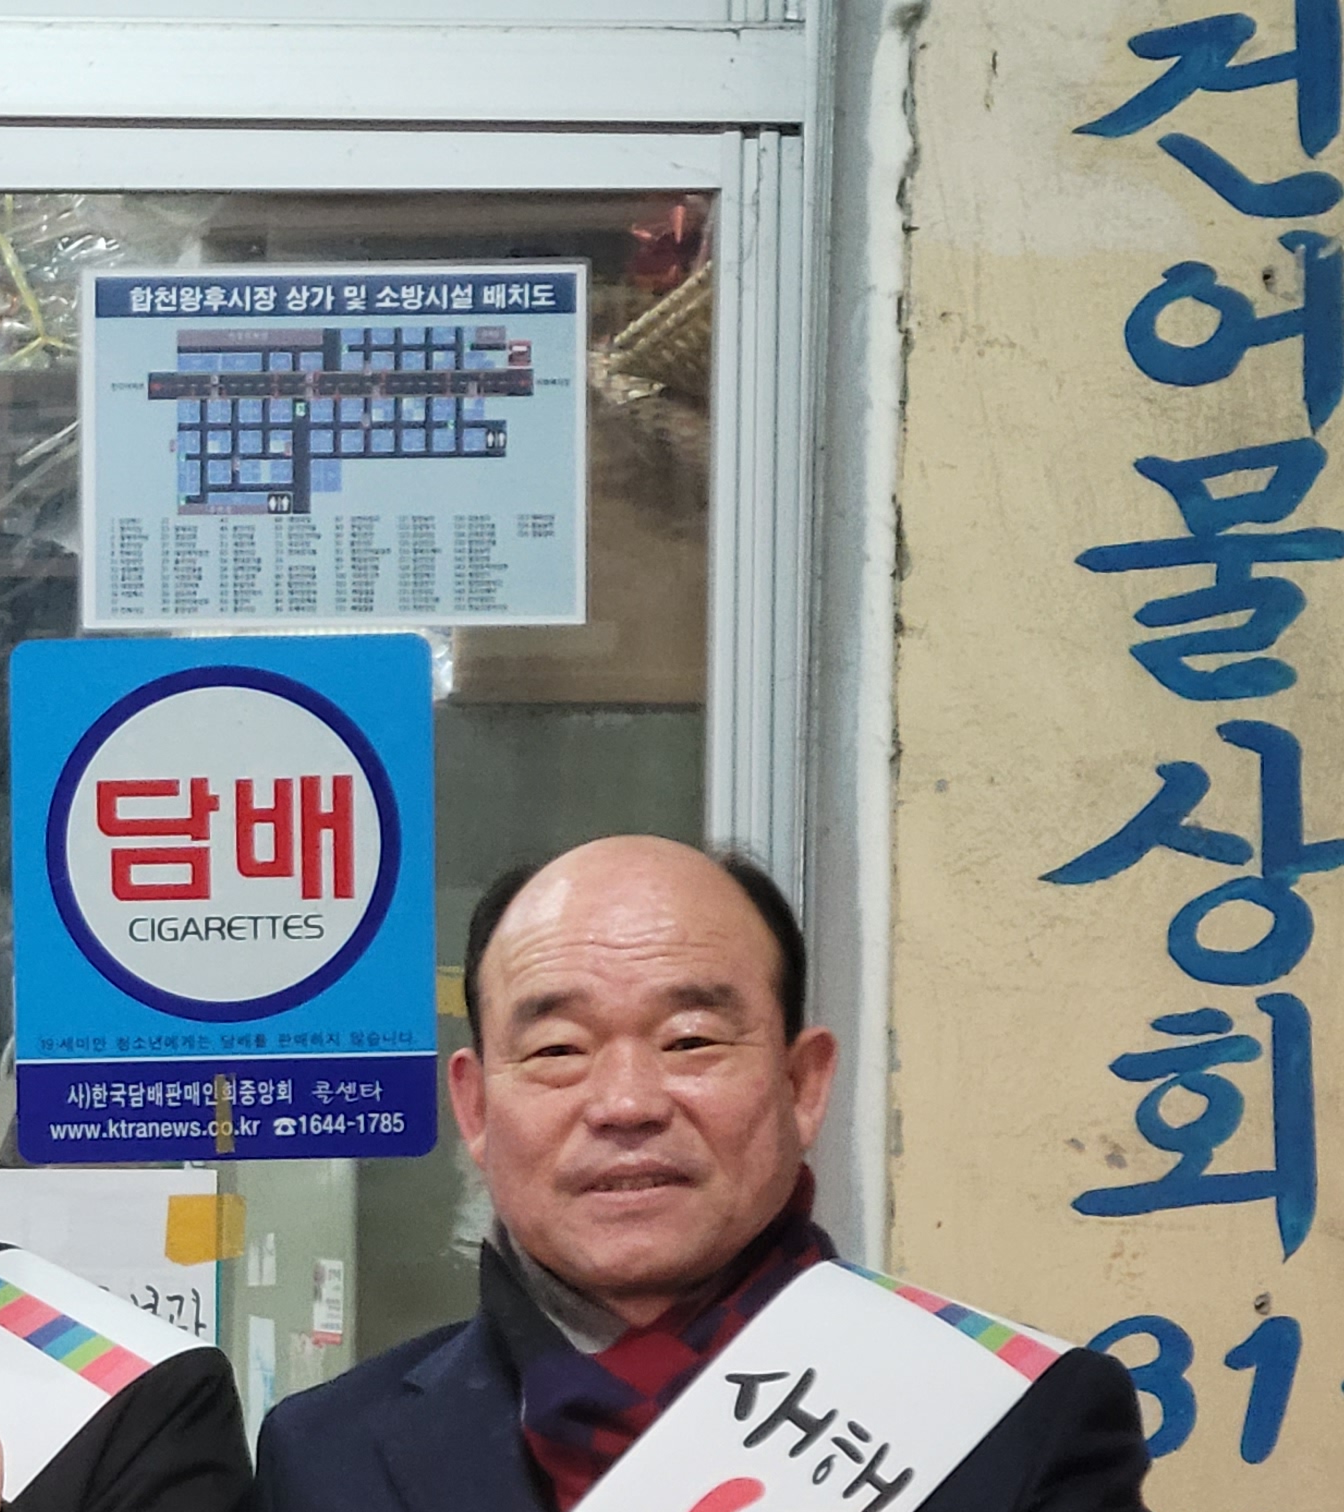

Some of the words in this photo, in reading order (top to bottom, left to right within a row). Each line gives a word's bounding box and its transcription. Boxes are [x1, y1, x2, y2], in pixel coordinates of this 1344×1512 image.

[129, 285, 278, 313] 합천왕후시장
[286, 285, 335, 312] 상가
[345, 284, 367, 311] 및
[376, 283, 473, 310] 소방시설
[483, 282, 556, 308] 배치도
[96, 775, 355, 902] 담배
[127, 914, 325, 943] CIGARETTES
[312, 1074, 384, 1104] 콜센타
[50, 1115, 261, 1141] www.ktranews.co.kr
[297, 1112, 406, 1136] 1644-1785
